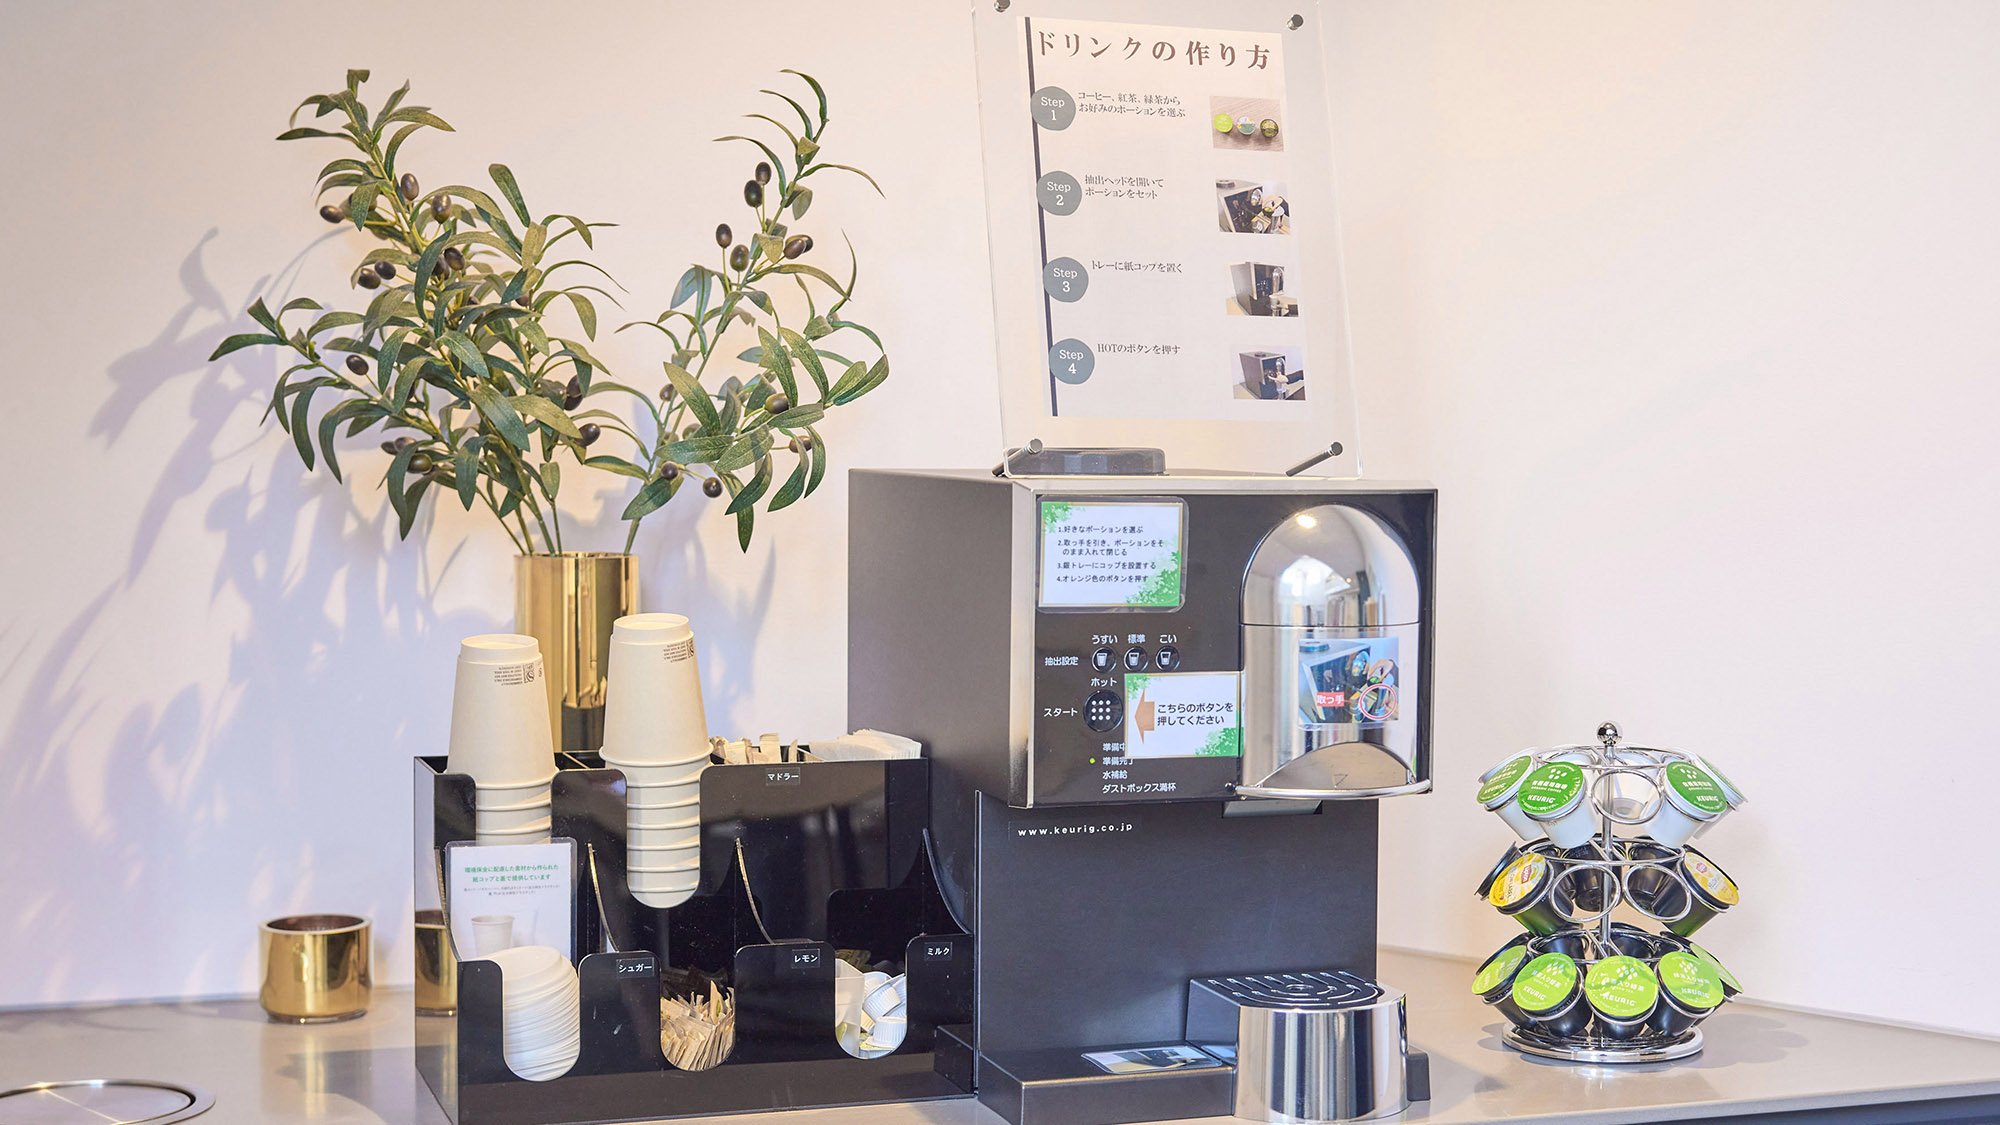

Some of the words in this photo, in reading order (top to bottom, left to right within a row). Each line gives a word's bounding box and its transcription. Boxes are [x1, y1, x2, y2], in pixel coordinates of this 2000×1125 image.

[1038, 30, 1271, 70] ドリンクの作り方
[1040, 96, 1065, 108] Step
[1078, 91, 1181, 105] コーヒー、紅茶、緑茶から
[1049, 111, 1058, 122] 1
[1084, 174, 1165, 188] 抽出ヘッドを開いて
[1046, 181, 1071, 193] Step
[1055, 194, 1065, 207] 2
[1092, 260, 1183, 273] トレーに紙コップを置く
[1053, 268, 1078, 279] Step
[1062, 281, 1071, 293] 3
[1097, 343, 1181, 355] HOTのボタンを押す
[1059, 349, 1084, 361] Step
[1068, 363, 1078, 374] 4
[1058, 526, 1143, 534] 1.好きなポーションを選ぶ
[1057, 539, 1164, 548] 2.取っ手を引き、ポーションをそ
[1062, 549, 1128, 557] のまま入れて閉じる
[1056, 575, 1149, 583] 4.オレンジ色のボタンを押す
[1091, 634, 1118, 645] うすい
[1128, 634, 1146, 644] 標準
[1159, 634, 1177, 644] こい
[1044, 656, 1079, 666] 抽出設定
[1090, 678, 1117, 687] ホット
[1317, 694, 1344, 704] 取っ手
[1043, 707, 1078, 717] スタート
[1157, 702, 1234, 714] こちらのボタンを
[1157, 714, 1225, 726] 押してください
[767, 771, 799, 782] マドラー
[1102, 769, 1128, 780] 水補給
[1102, 782, 1177, 794] ダストボックス満杯
[1527, 794, 1555, 804] KEURIG
[1018, 823, 1133, 836] www.keurig.co.jp
[926, 946, 950, 956] ミルク
[794, 953, 818, 963] レモン
[618, 962, 652, 974] シュガー
